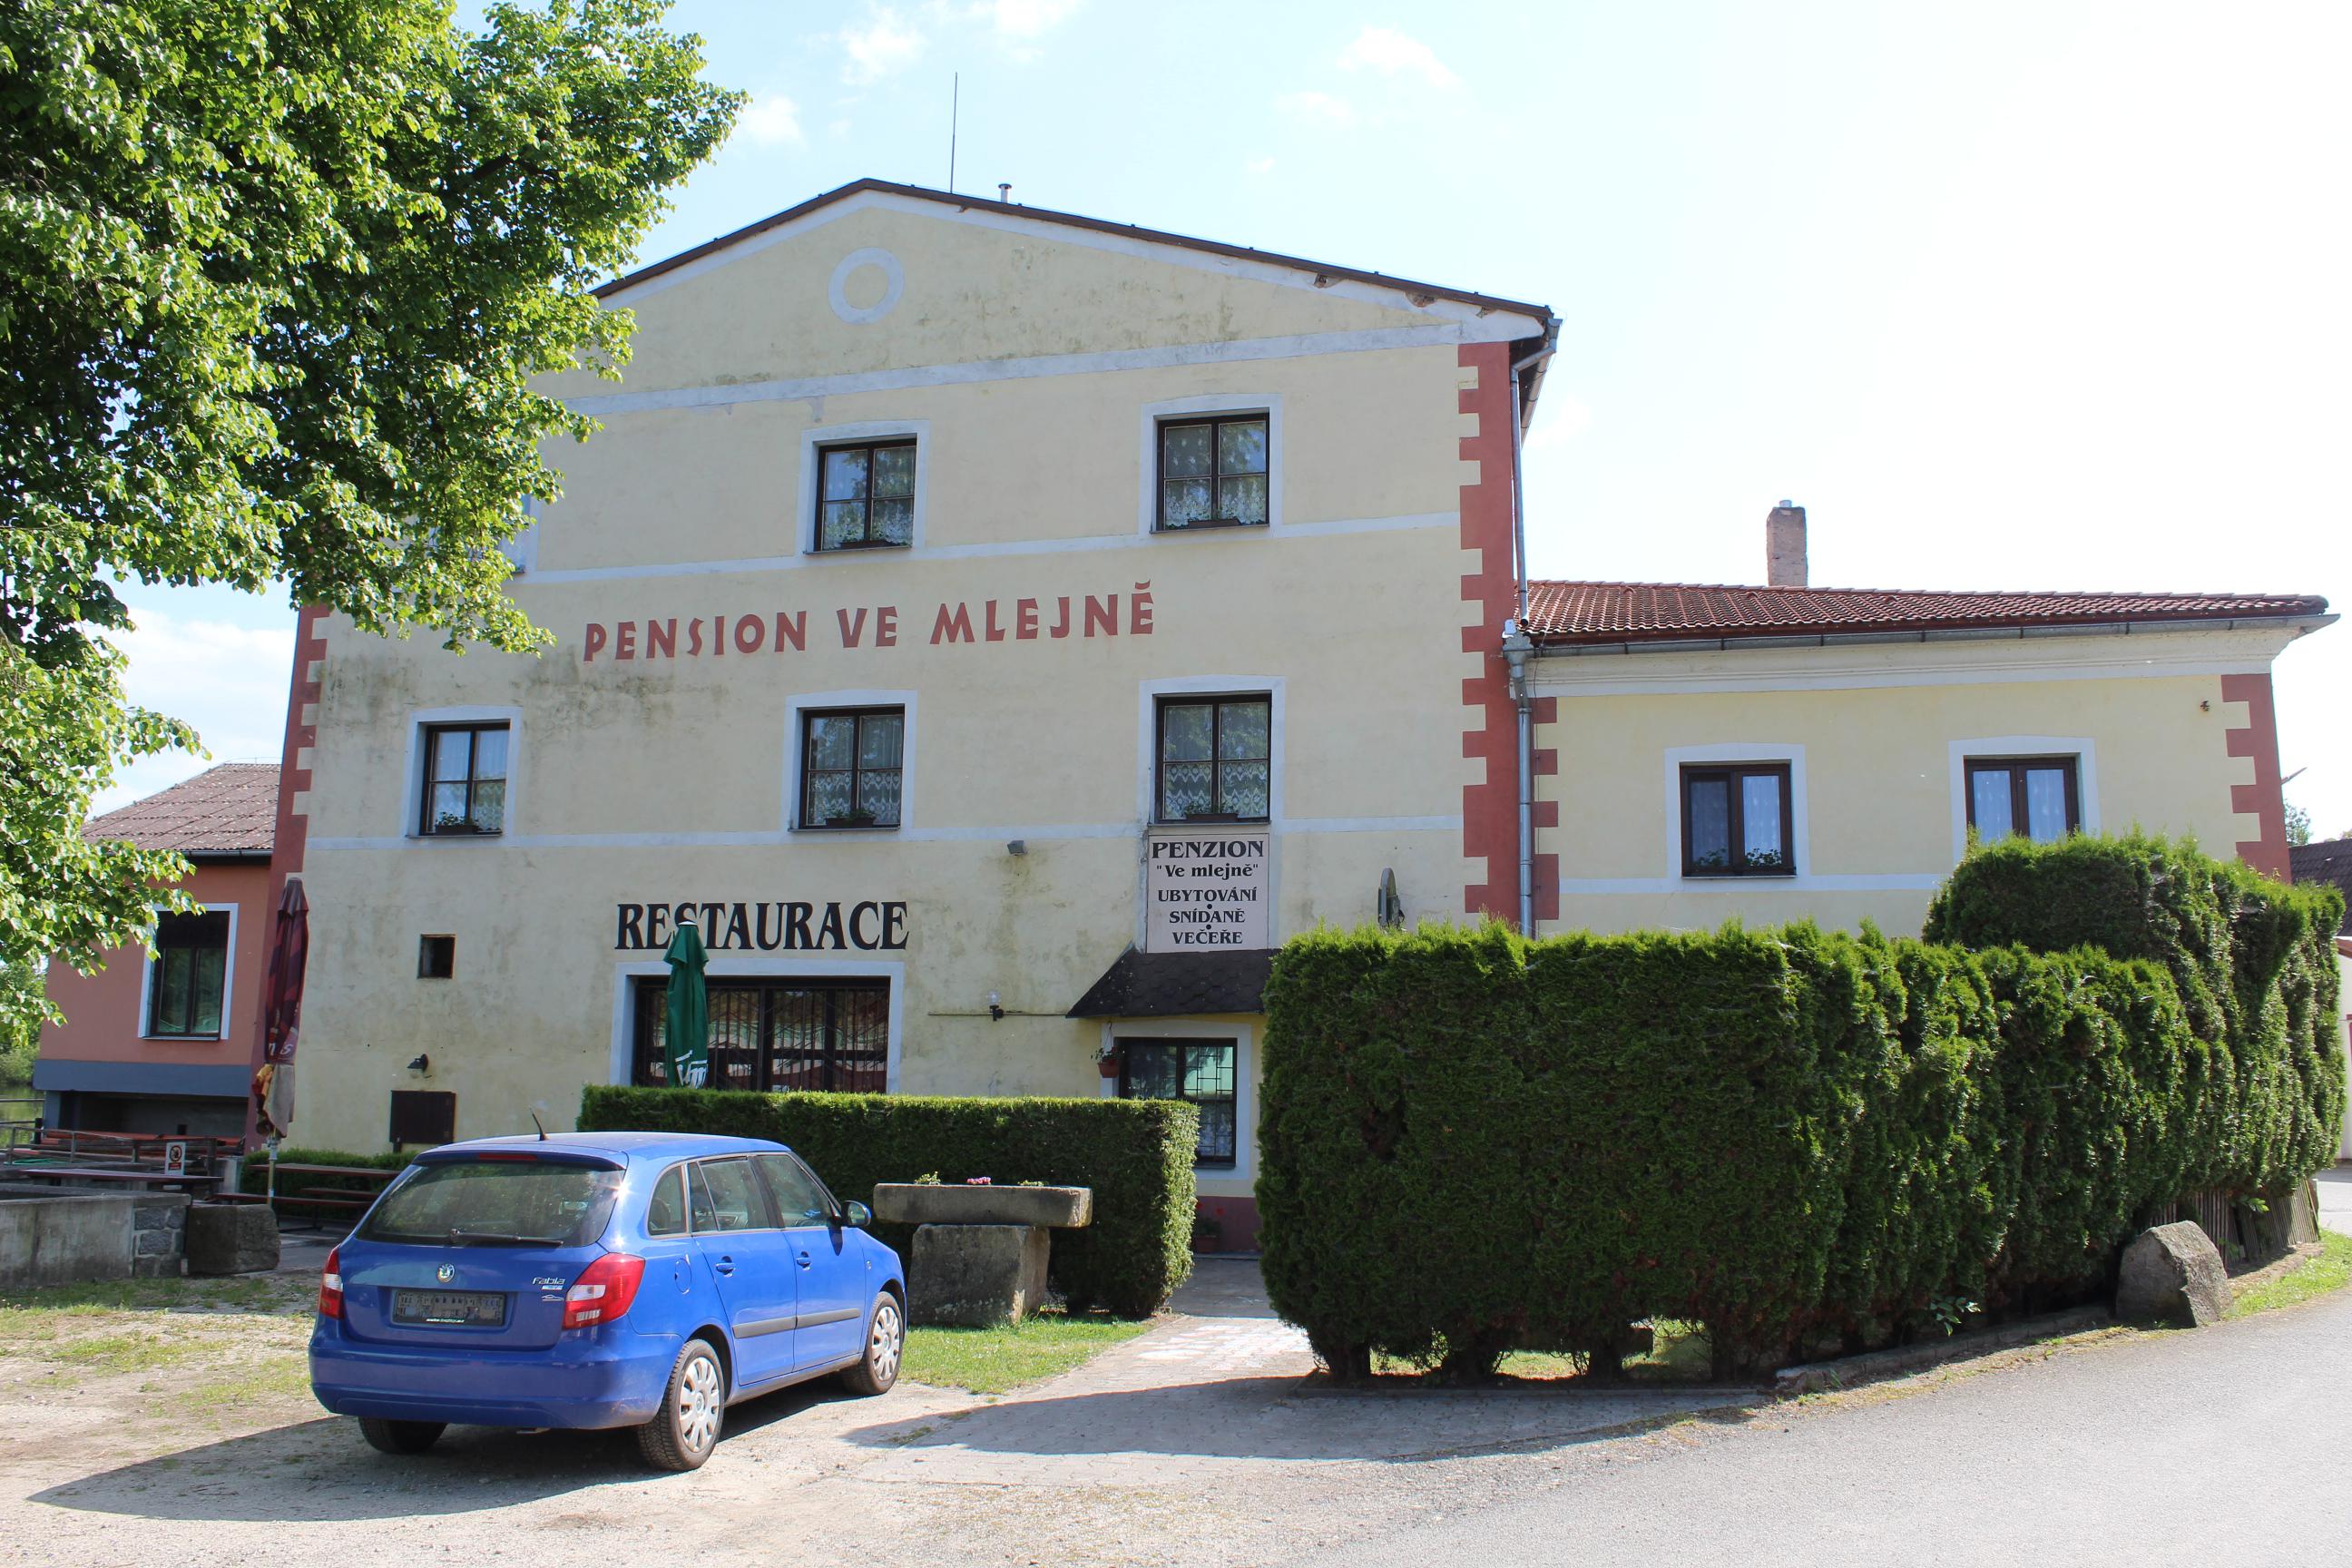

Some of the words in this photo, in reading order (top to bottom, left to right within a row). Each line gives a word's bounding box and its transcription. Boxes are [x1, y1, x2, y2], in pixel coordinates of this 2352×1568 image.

[583, 611, 807, 662] PENSION
[837, 606, 898, 648] VE
[930, 579, 1154, 645] MLEJNĚ
[1152, 840, 1263, 858] PENZION
[1191, 863, 1259, 880] mlejně"
[1158, 887, 1257, 902] UBYTOVÁNÍ
[1169, 908, 1245, 923] SNÍDANĚ
[1172, 929, 1242, 945] VEČEŘE
[532, 1277, 565, 1285] Fabia
